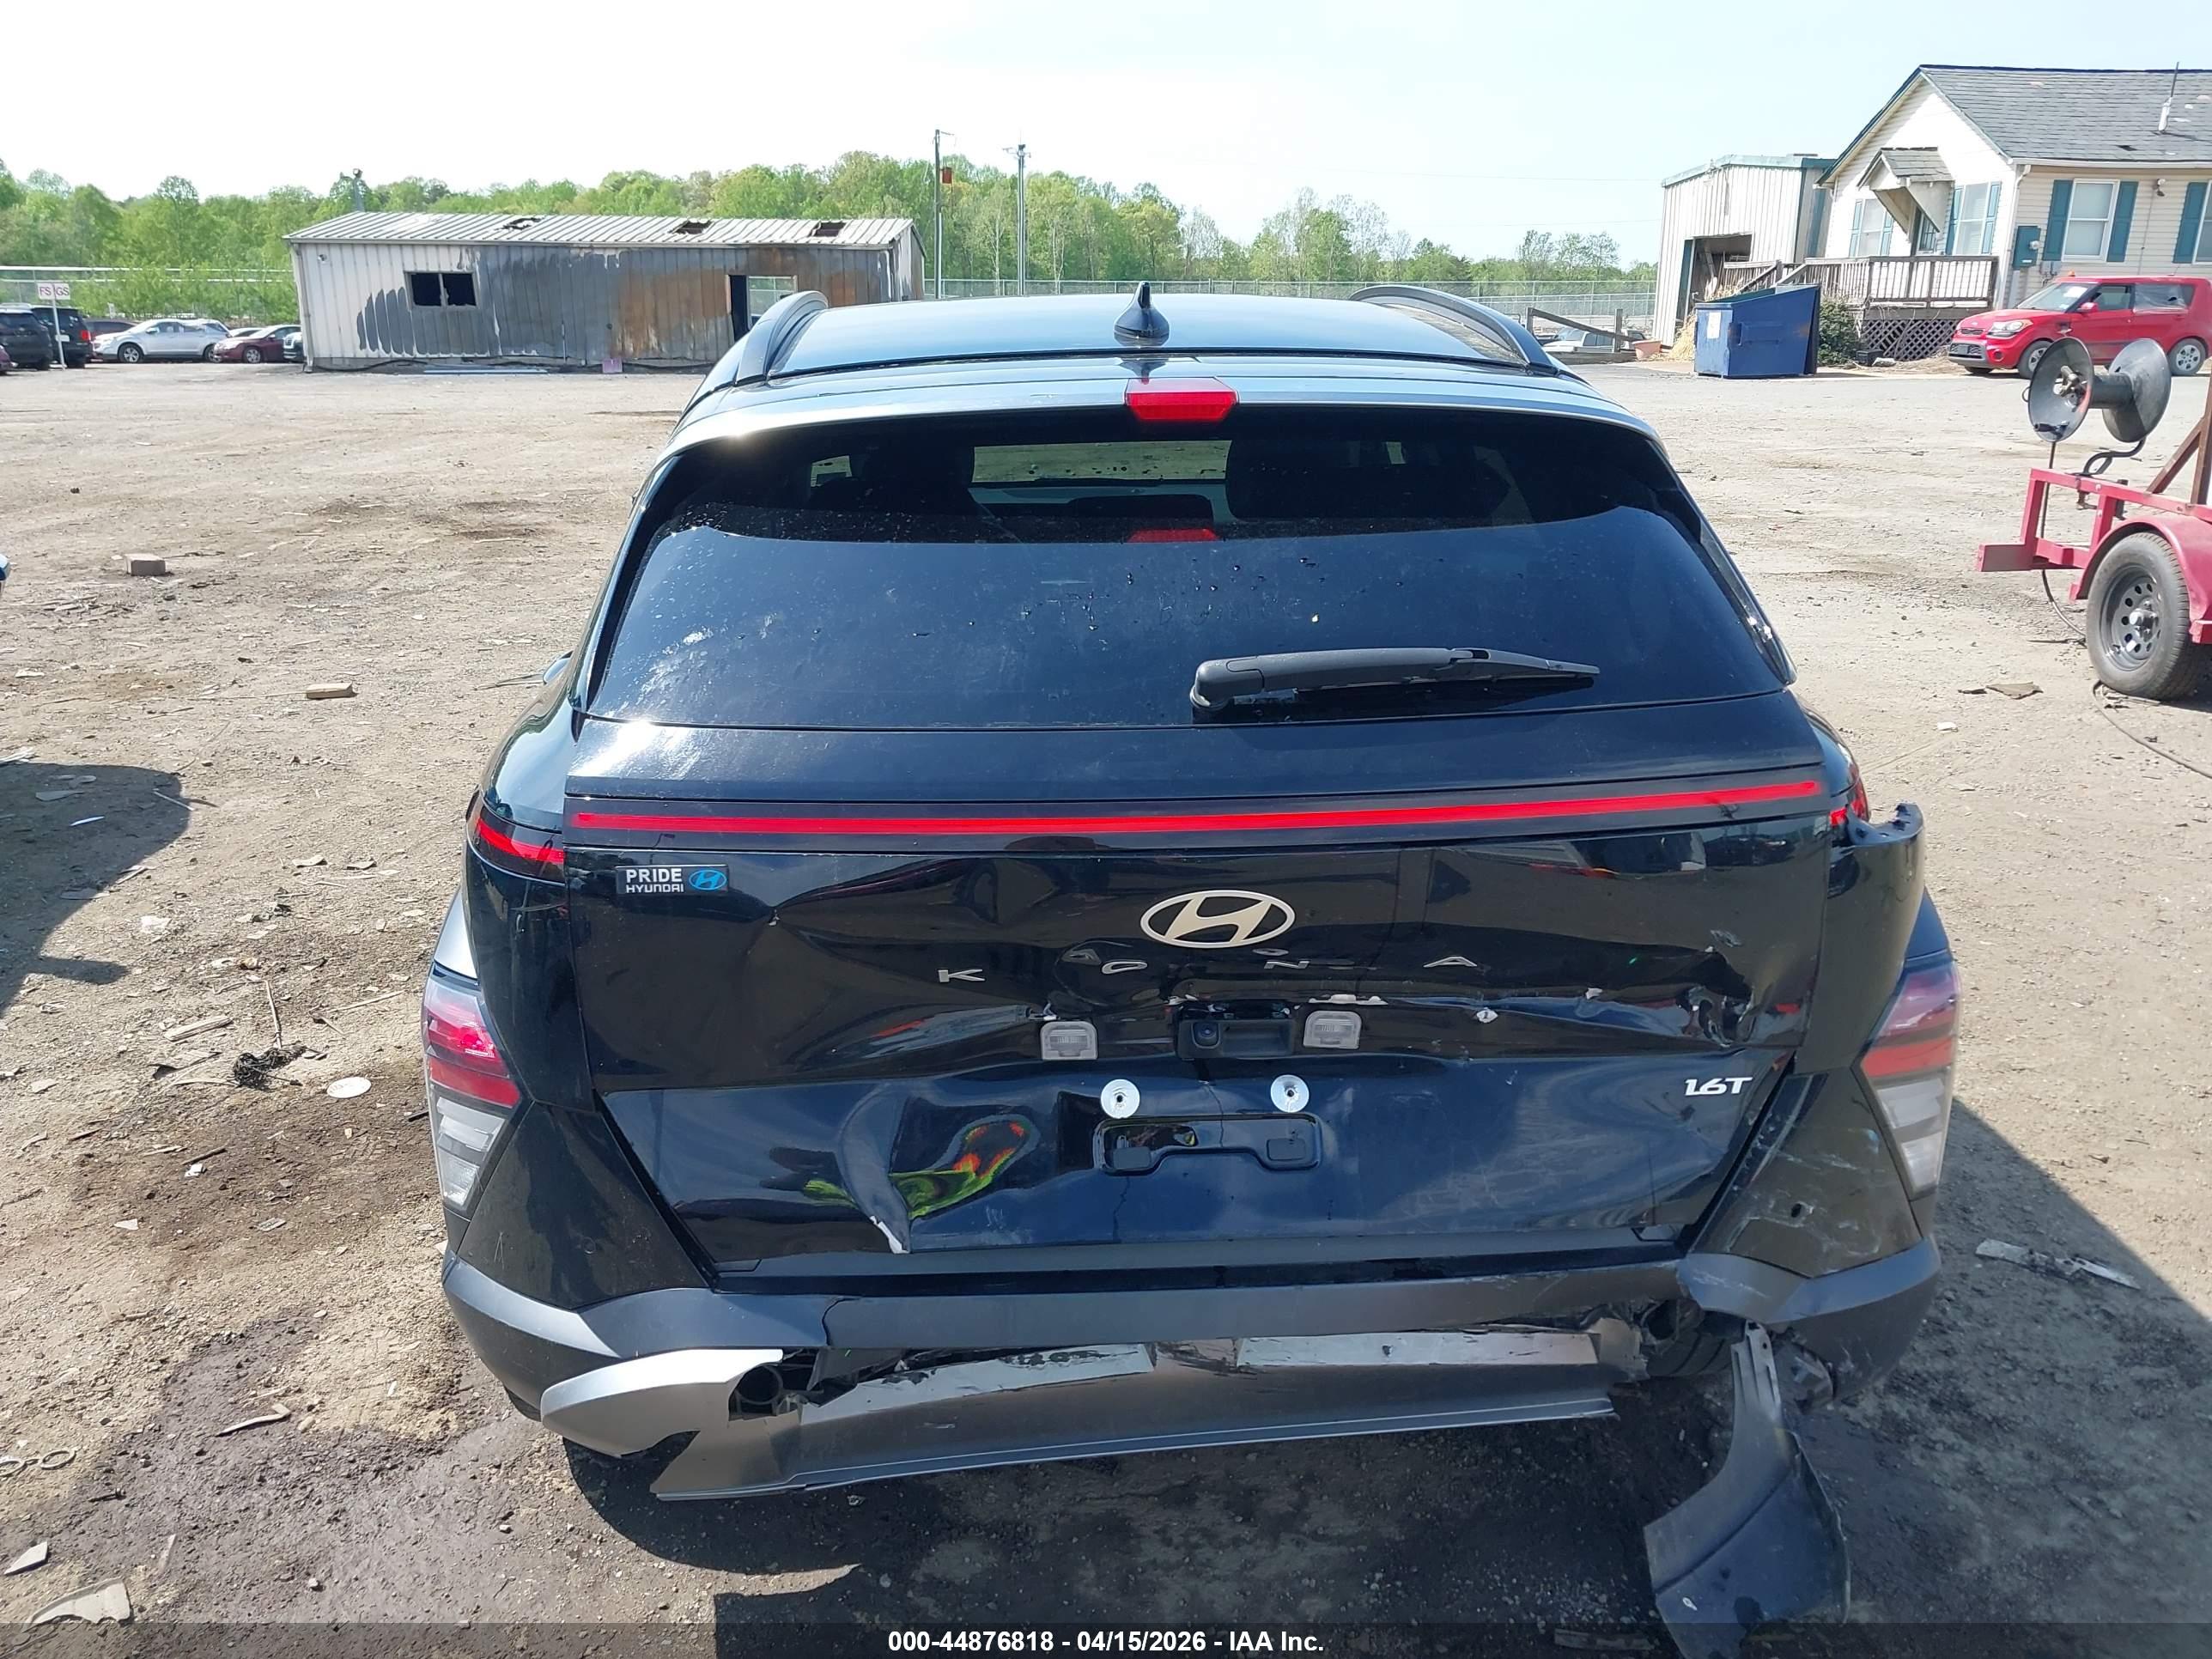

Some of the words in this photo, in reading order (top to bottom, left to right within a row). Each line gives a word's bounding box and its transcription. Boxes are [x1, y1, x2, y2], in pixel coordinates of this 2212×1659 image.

[626, 868, 683, 883] PRIDE
[626, 884, 684, 893] HYUNDAI
[938, 956, 1478, 983] KONA
